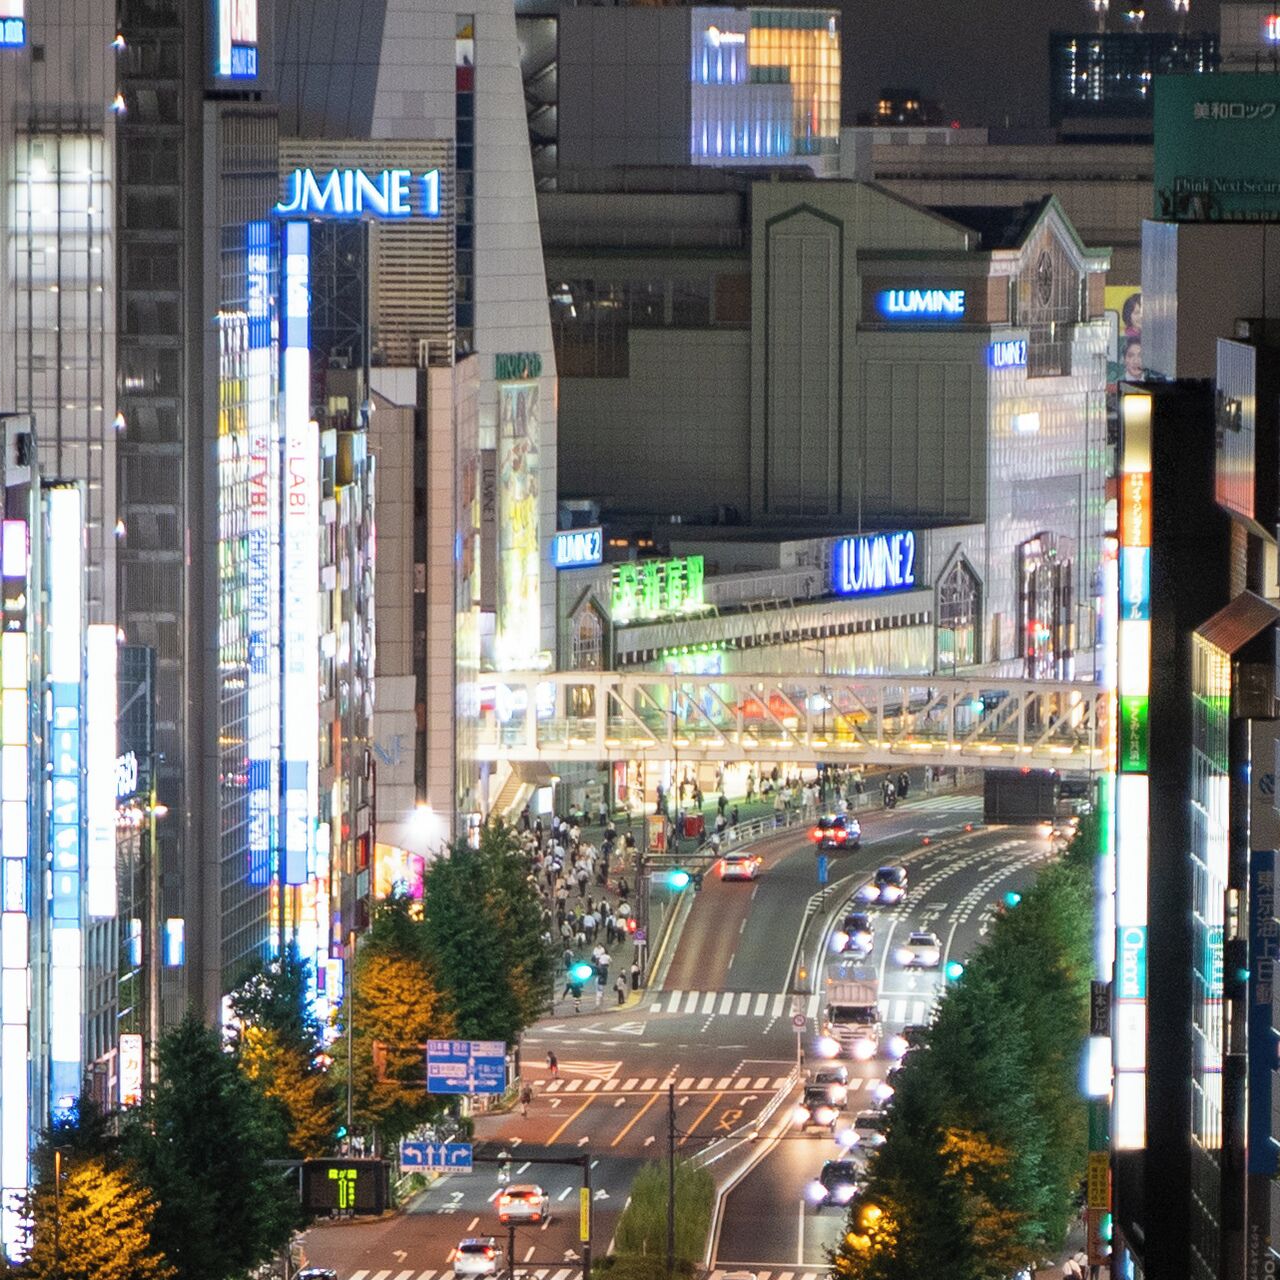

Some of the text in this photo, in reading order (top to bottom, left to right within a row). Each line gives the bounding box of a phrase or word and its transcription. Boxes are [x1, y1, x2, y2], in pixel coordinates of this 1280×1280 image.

[1193, 102, 1276, 120] 美和ロック
[423, 169, 440, 213] 1
[1176, 178, 1209, 193] Think
[1213, 179, 1241, 193] Next
[888, 289, 965, 313] LUMINE
[993, 340, 1027, 367] LUMINE 2
[289, 456, 305, 516] LABI
[557, 532, 600, 563] LUMINE 2
[842, 531, 915, 593] LUMINE 2
